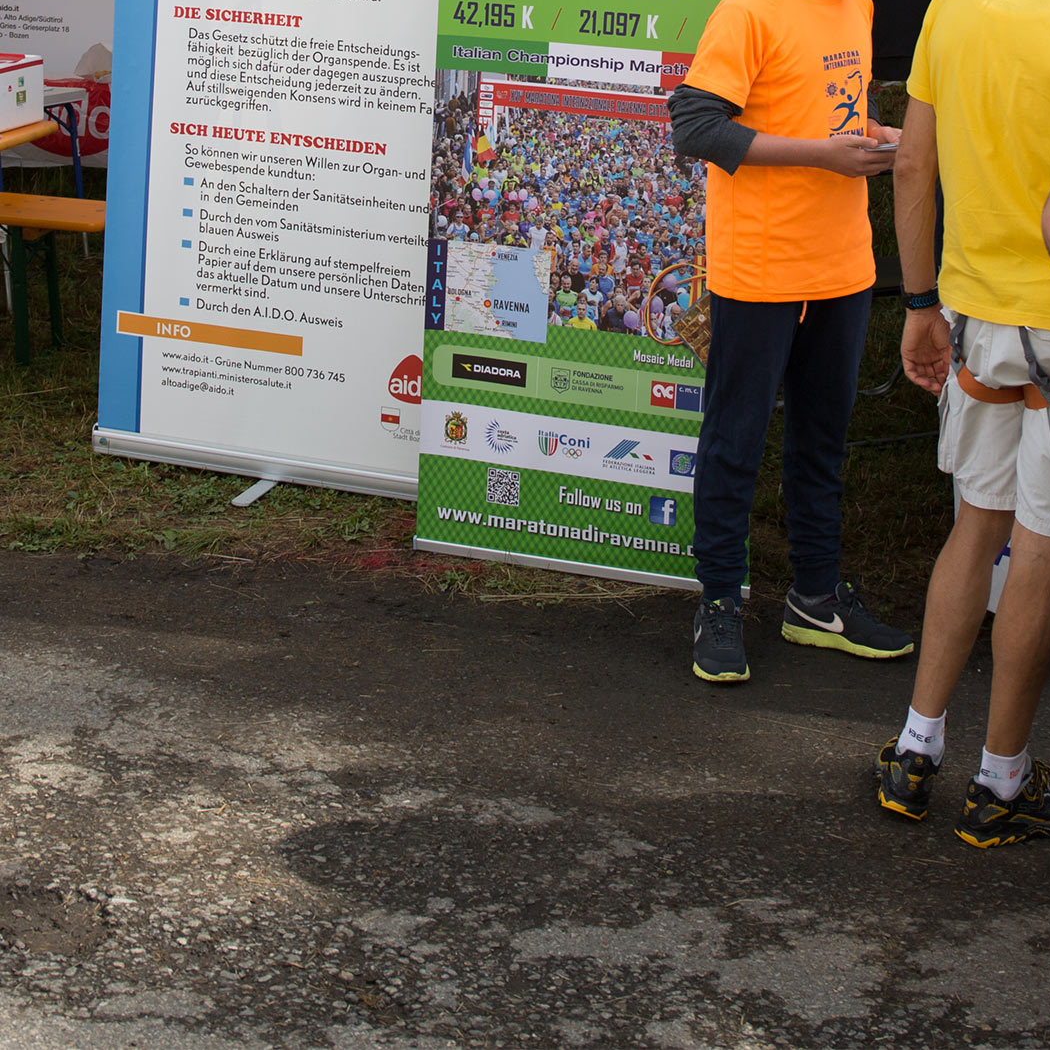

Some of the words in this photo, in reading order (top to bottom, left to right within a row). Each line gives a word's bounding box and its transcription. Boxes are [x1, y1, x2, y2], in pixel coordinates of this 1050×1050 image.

[174, 6, 201, 19] DIE
[205, 8, 303, 28] SICHERHEIT
[453, 1, 515, 29] 42,195
[521, 6, 534, 30] K
[579, 10, 641, 38] 21,097
[646, 15, 658, 40] K
[452, 45, 502, 62] Italian
[507, 50, 624, 73] Championship
[823, 50, 860, 63] MARATONA
[525, 91, 560, 106] MARATONA
[562, 95, 615, 112] INTERNAZIONALE
[616, 100, 647, 115] RAVENNA
[170, 122, 208, 136] SICH
[212, 125, 266, 143] HEUTE
[270, 132, 387, 155] ENTSCHEIDEN
[497, 252, 518, 261] VENEZIA
[431, 244, 444, 325] ITALY
[447, 287, 472, 296] BOLOGNA
[493, 299, 530, 314] RAVENNA
[156, 322, 191, 338] INFO
[162, 351, 210, 364] www.aido.it
[214, 356, 242, 370] Grüne
[243, 360, 283, 375] Nummer
[284, 365, 305, 378] 800
[306, 368, 326, 381] 736
[327, 371, 346, 384] 745
[633, 350, 665, 366] Mosaic
[667, 354, 694, 370] Medal
[161, 366, 292, 390] www.trapianti.ministerosalute.it
[473, 364, 521, 380] DIADORA
[572, 370, 614, 382] FONDAZIONE
[161, 378, 235, 396] altoadige@aido.it
[571, 378, 589, 386] CASSA
[597, 382, 625, 391] RISPARMIO
[580, 386, 603, 395] RAVENNA
[538, 429, 559, 438] Italia
[559, 434, 590, 450] Coni
[559, 486, 600, 510] Follow
[605, 499, 622, 512] us
[625, 502, 642, 516] on
